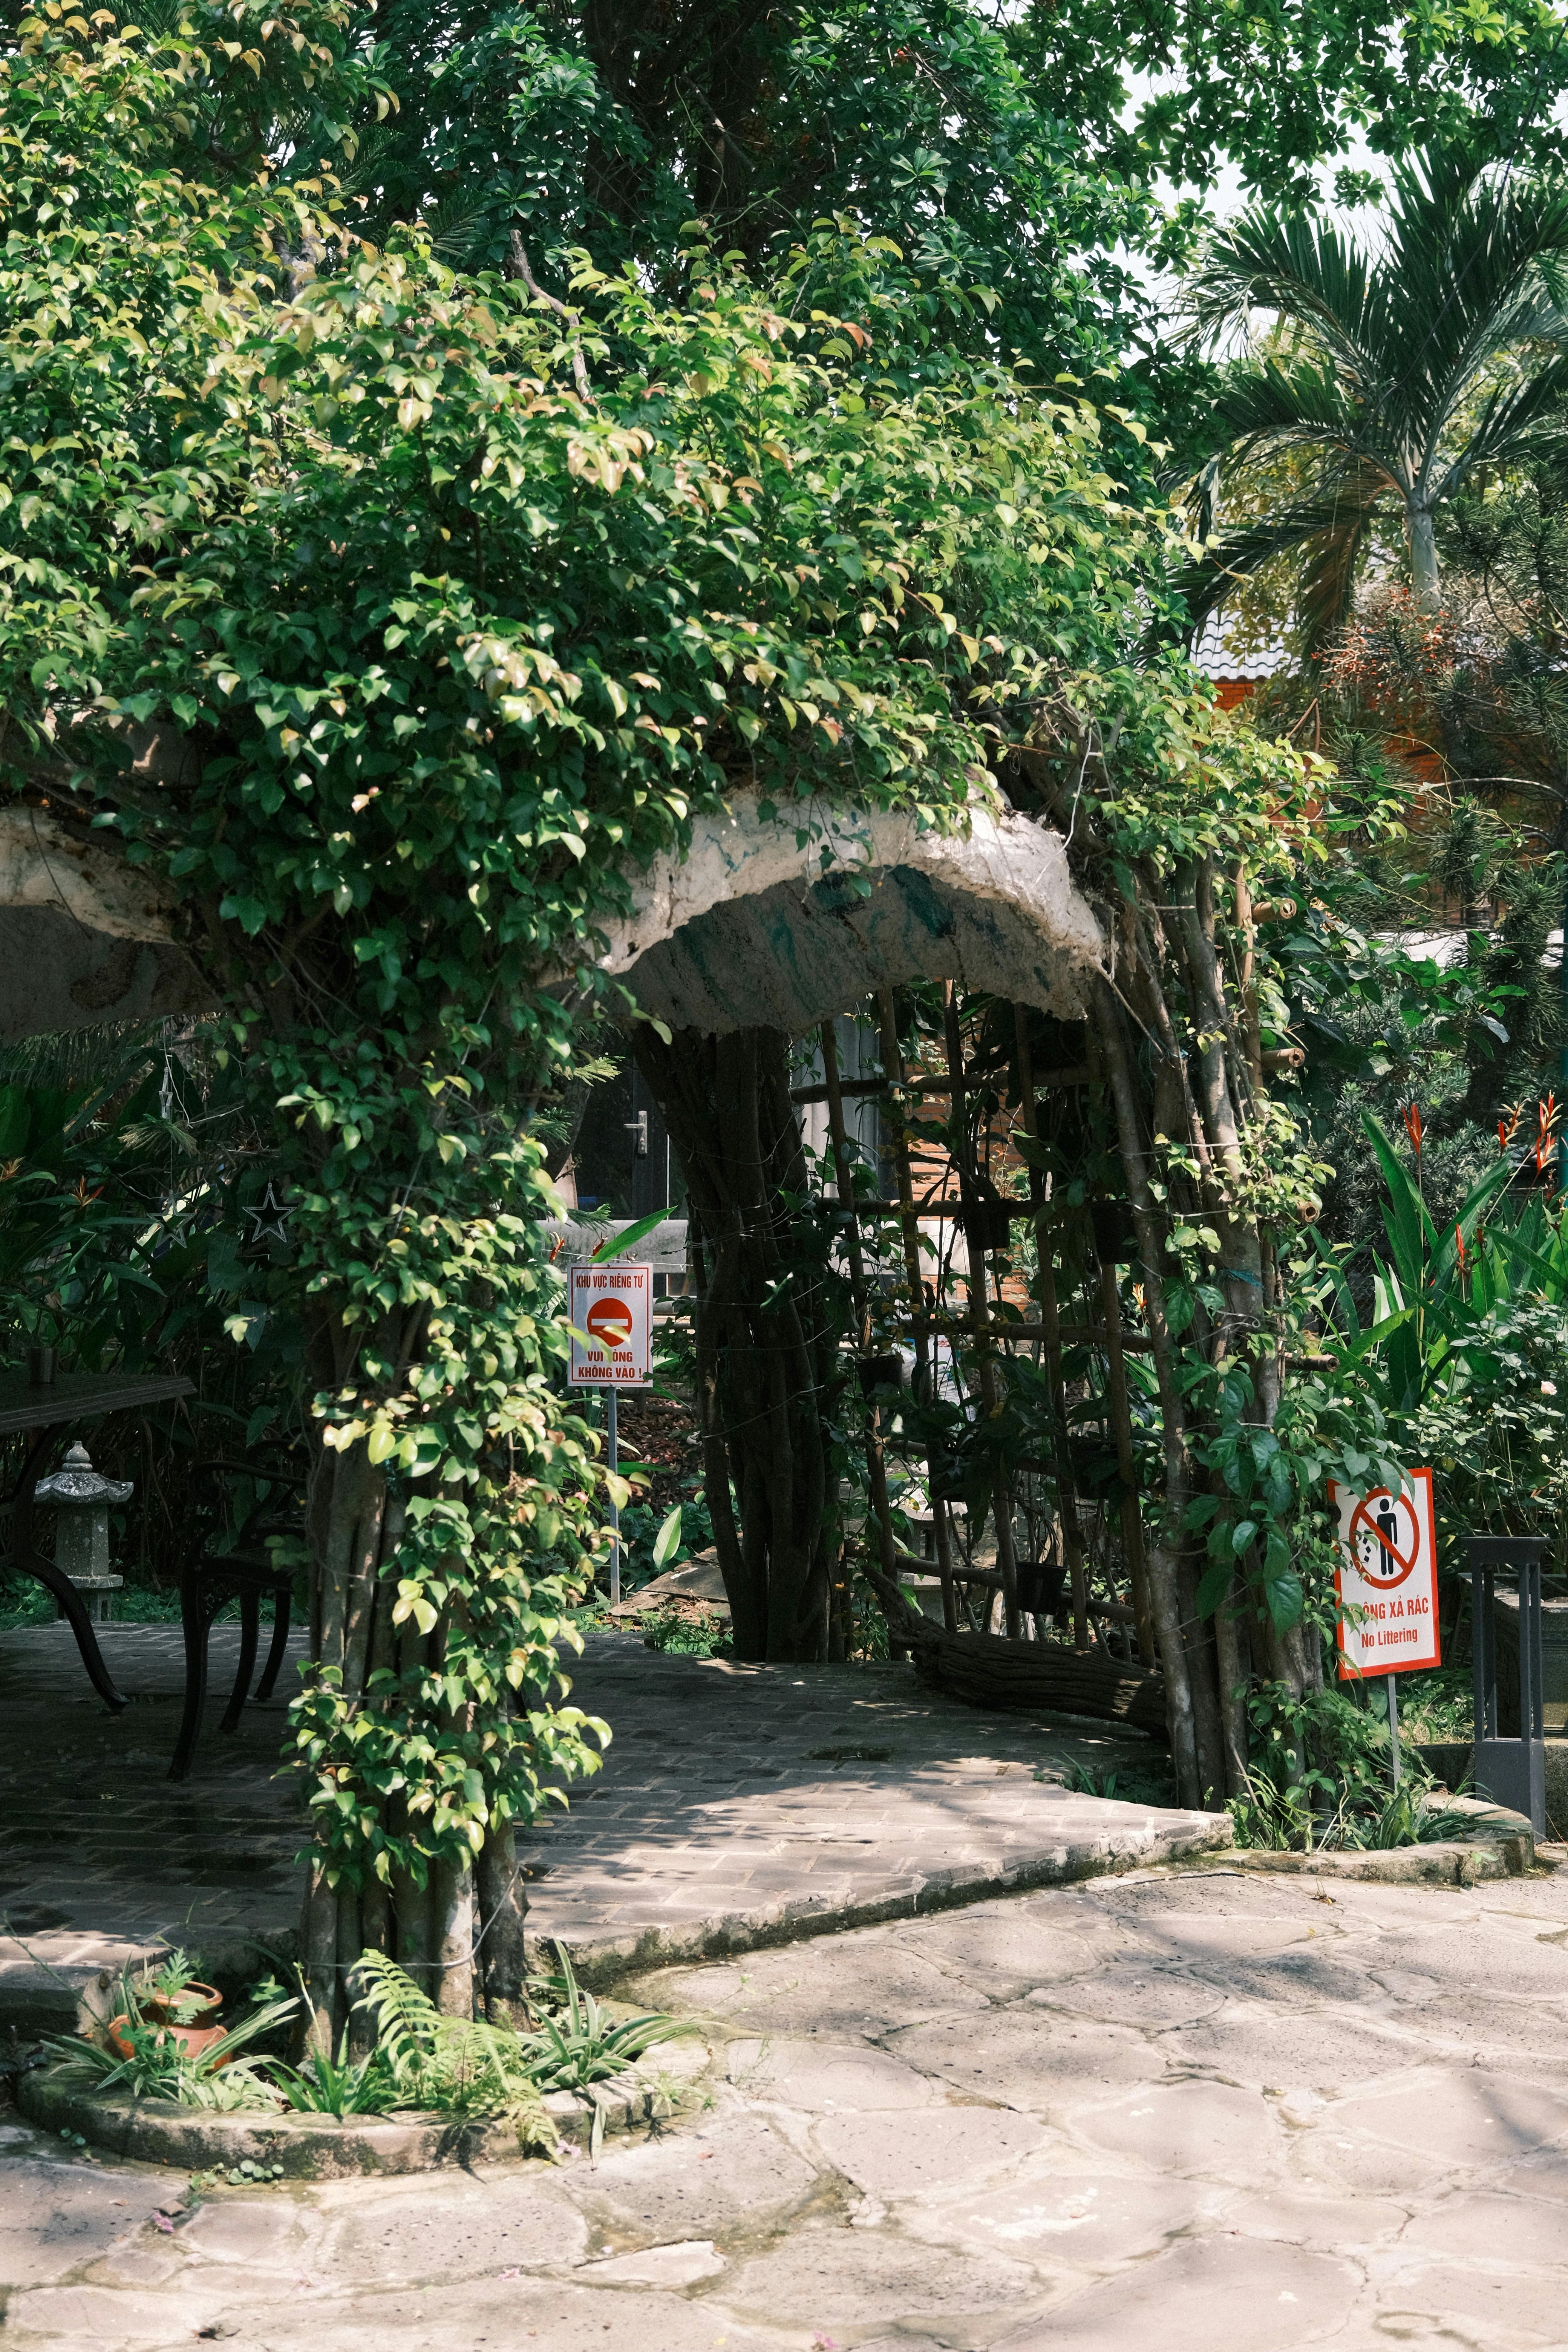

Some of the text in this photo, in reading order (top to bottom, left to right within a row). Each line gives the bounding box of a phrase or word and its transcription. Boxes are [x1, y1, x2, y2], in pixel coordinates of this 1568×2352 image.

[576, 1273, 643, 1291] KHU VỰC RIÊNG TƯ
[587, 1349, 633, 1362] VUI ÒNG
[578, 1365, 642, 1378] KHÔNG VÀO !
[1347, 1594, 1429, 1623] ÔNG XẢ RÁC
[1361, 1628, 1418, 1648] No Littering
